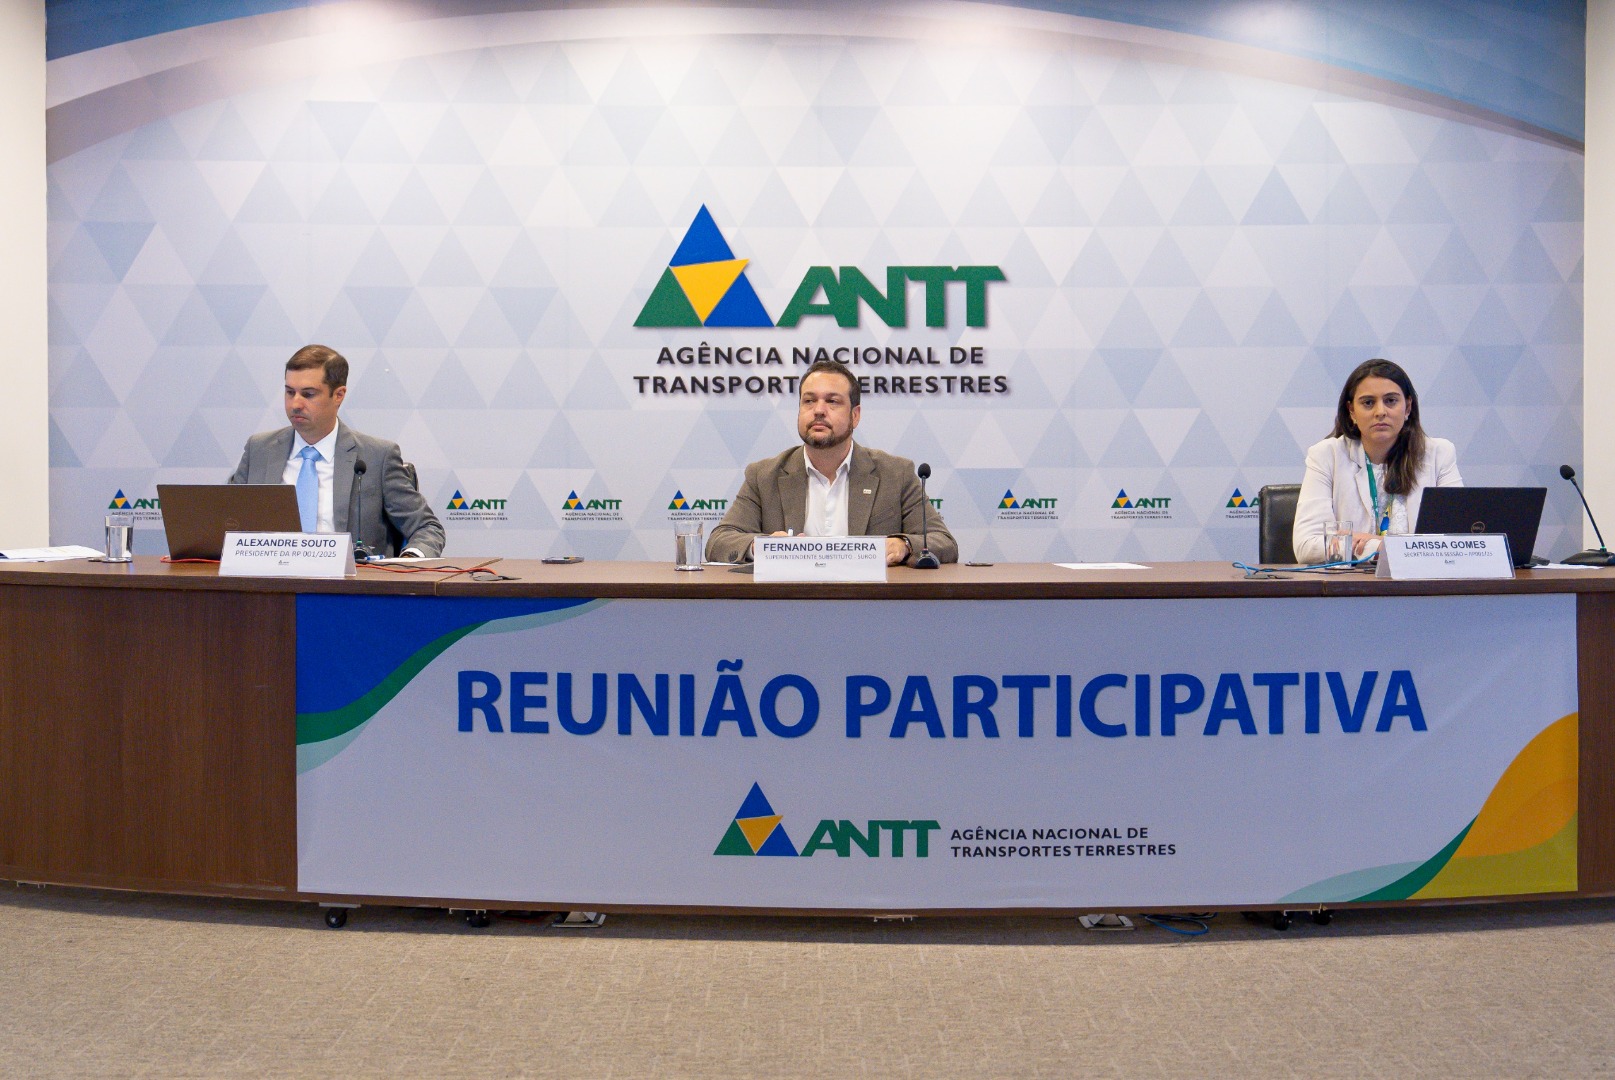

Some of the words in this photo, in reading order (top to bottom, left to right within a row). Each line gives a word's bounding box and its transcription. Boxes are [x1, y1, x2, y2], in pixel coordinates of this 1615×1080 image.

[776, 265, 1007, 328] ANTT
[656, 341, 783, 365] AGÊNCIA
[792, 346, 941, 365] NACIONAL
[949, 346, 985, 364] DE
[633, 376, 800, 394] TRANSPORT
[861, 376, 1009, 394] ERRESTRES
[133, 498, 161, 509] ANT
[470, 499, 507, 509] ANTT
[585, 499, 622, 510] ANTT
[691, 499, 728, 510] ANTT
[1020, 498, 1057, 508] ANTT
[1134, 498, 1171, 508] ANTT
[236, 538, 298, 547] ALEXANDRE
[300, 539, 337, 548] SOUTO
[763, 543, 823, 552] FERNANDO
[826, 542, 877, 551] BEZERRA
[1405, 541, 1448, 550] LARISSA
[1450, 540, 1487, 549] GOMES
[457, 659, 820, 738] REUNIÃO
[845, 669, 1428, 739] PARTICIPATIVA
[800, 819, 941, 858] ANTT
[950, 826, 1027, 841] AGÊNCIA
[1032, 827, 1123, 841] NACIONAL
[1127, 827, 1149, 840] DE
[951, 845, 1072, 858] TRANSPORTES
[1073, 844, 1177, 858] TERRESTRES
